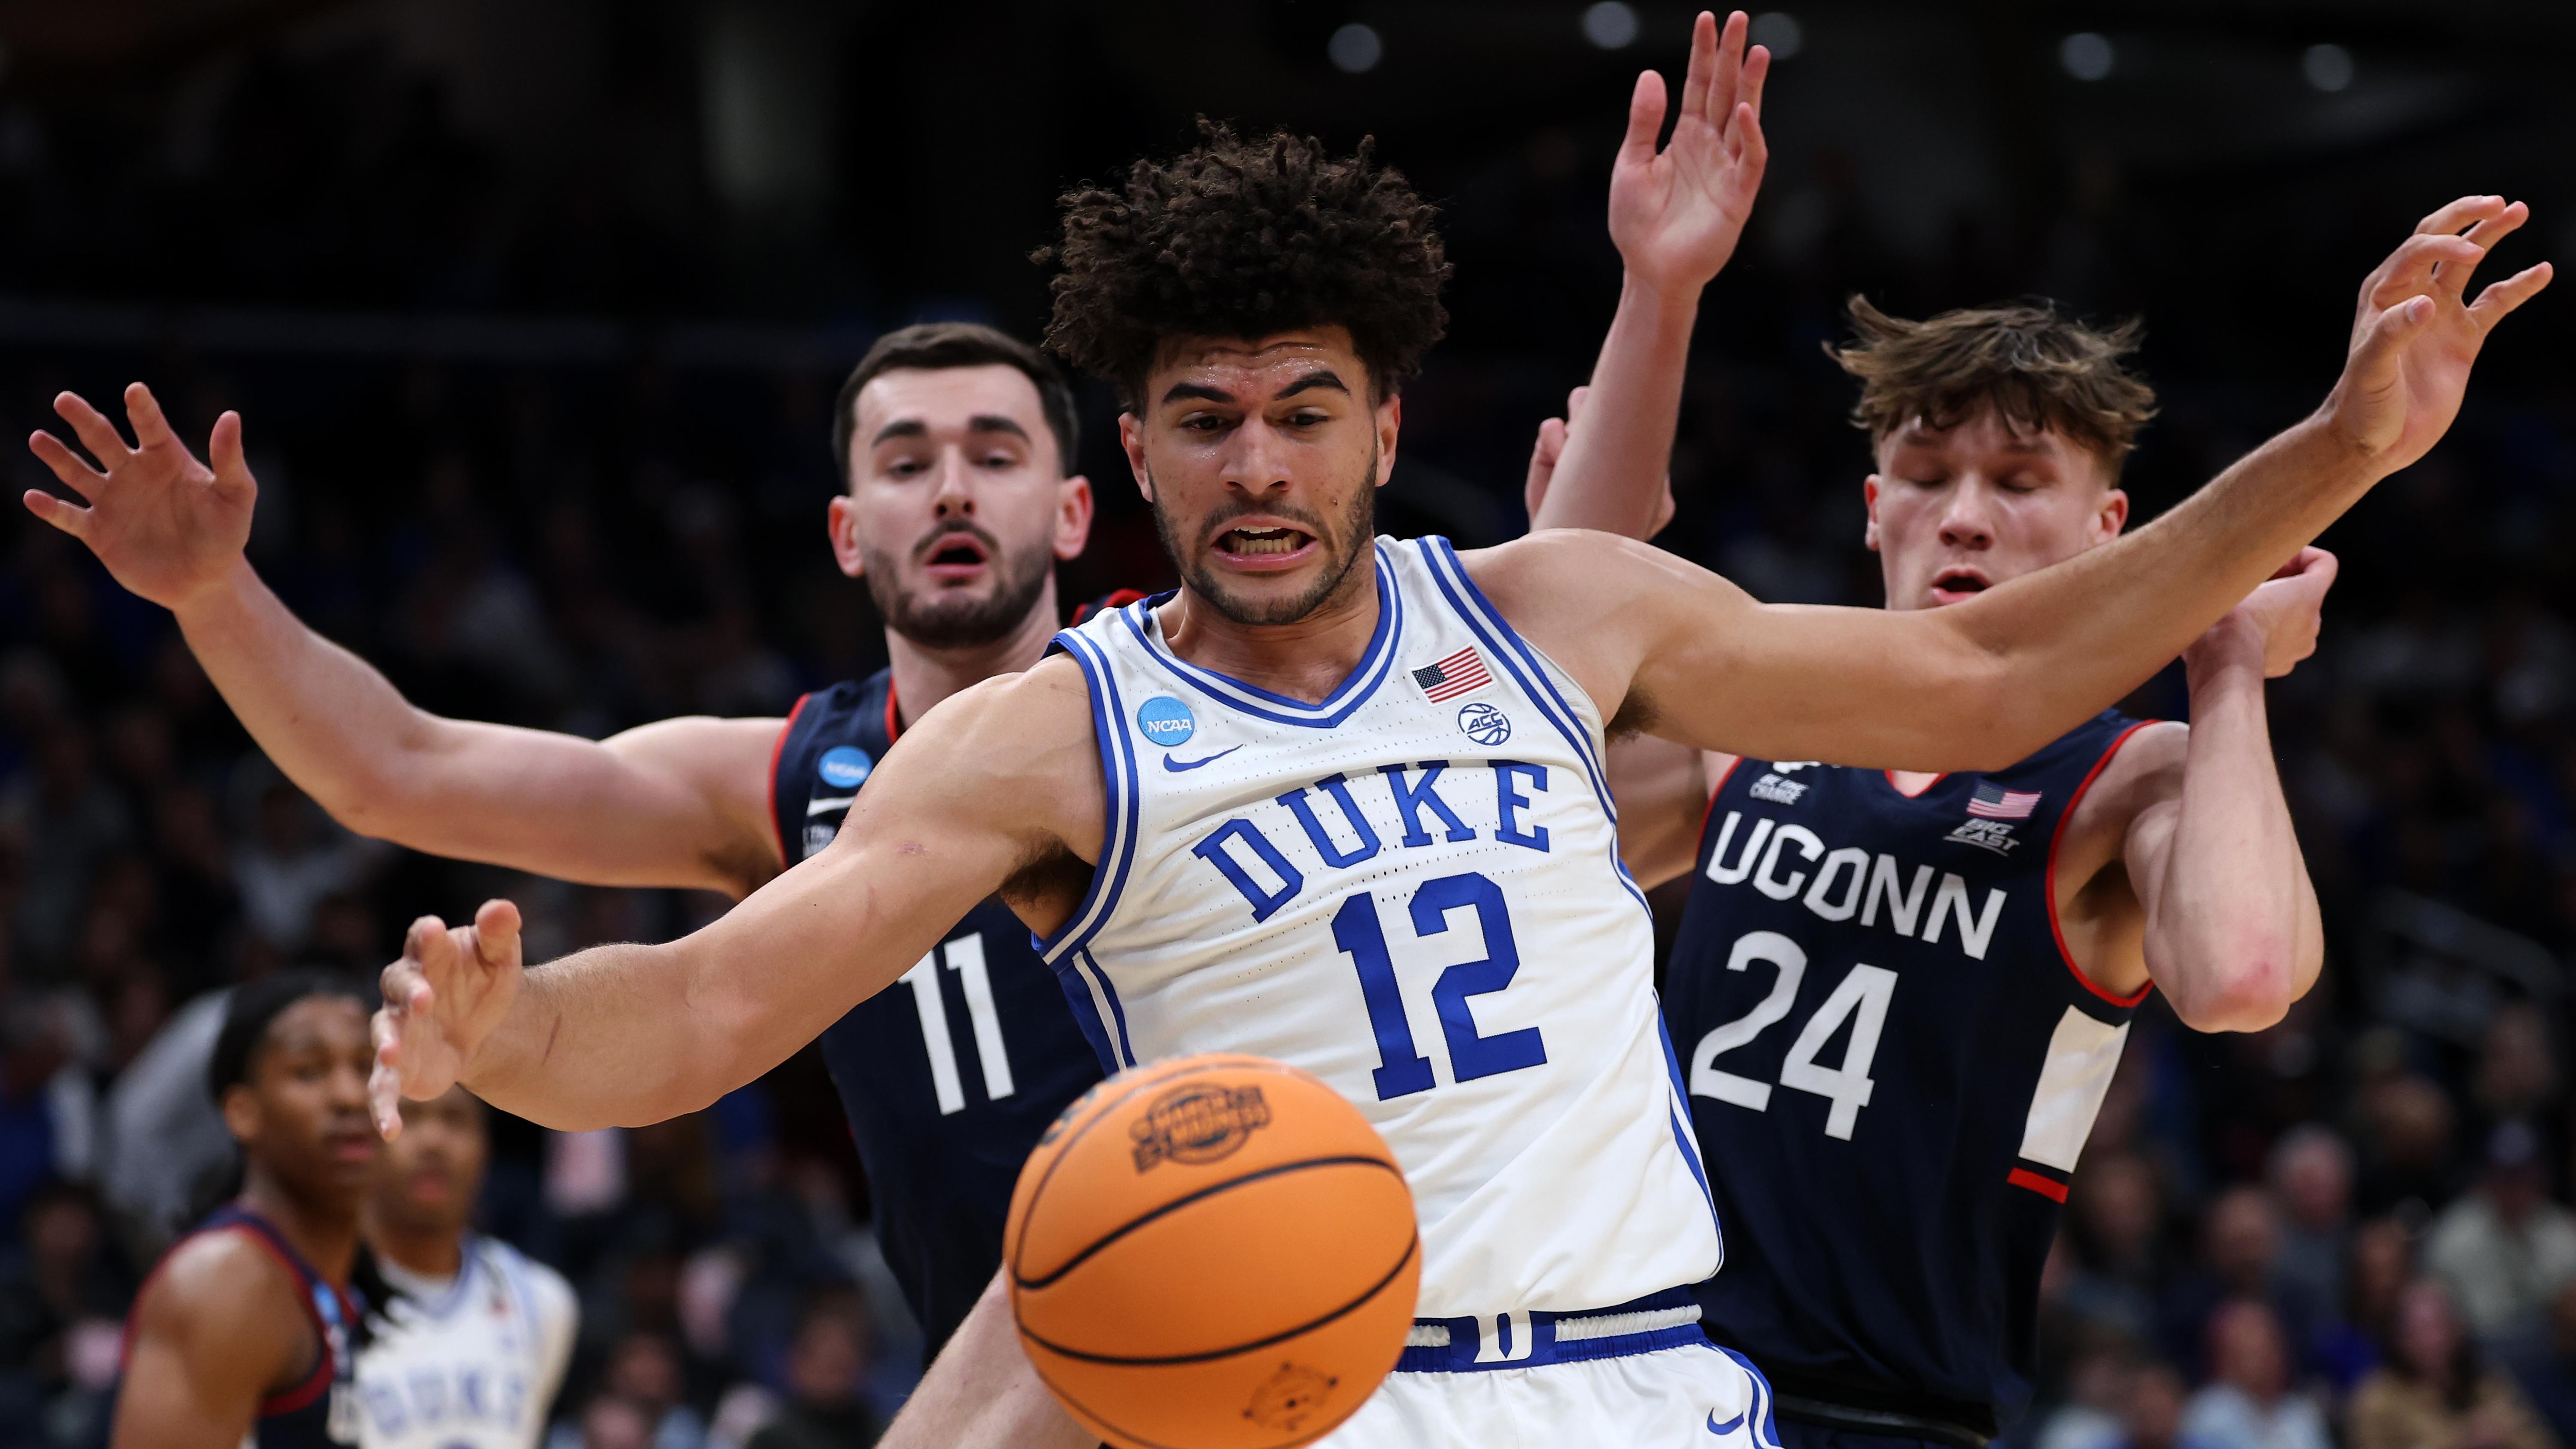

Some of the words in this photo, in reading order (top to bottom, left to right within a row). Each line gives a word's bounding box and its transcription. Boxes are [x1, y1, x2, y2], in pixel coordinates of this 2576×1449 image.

[1147, 719, 1193, 734] NCAA
[1468, 711, 1503, 730] ACC
[825, 761, 868, 779] NCAA
[1191, 759, 1550, 924] DUKE
[1951, 825, 2021, 851] EAST
[1963, 817, 2015, 836] BIG
[1706, 810, 2007, 961] UCONN
[897, 931, 1015, 1116] 11
[1330, 871, 1548, 1101] 12
[1689, 930, 1899, 1141] 24
